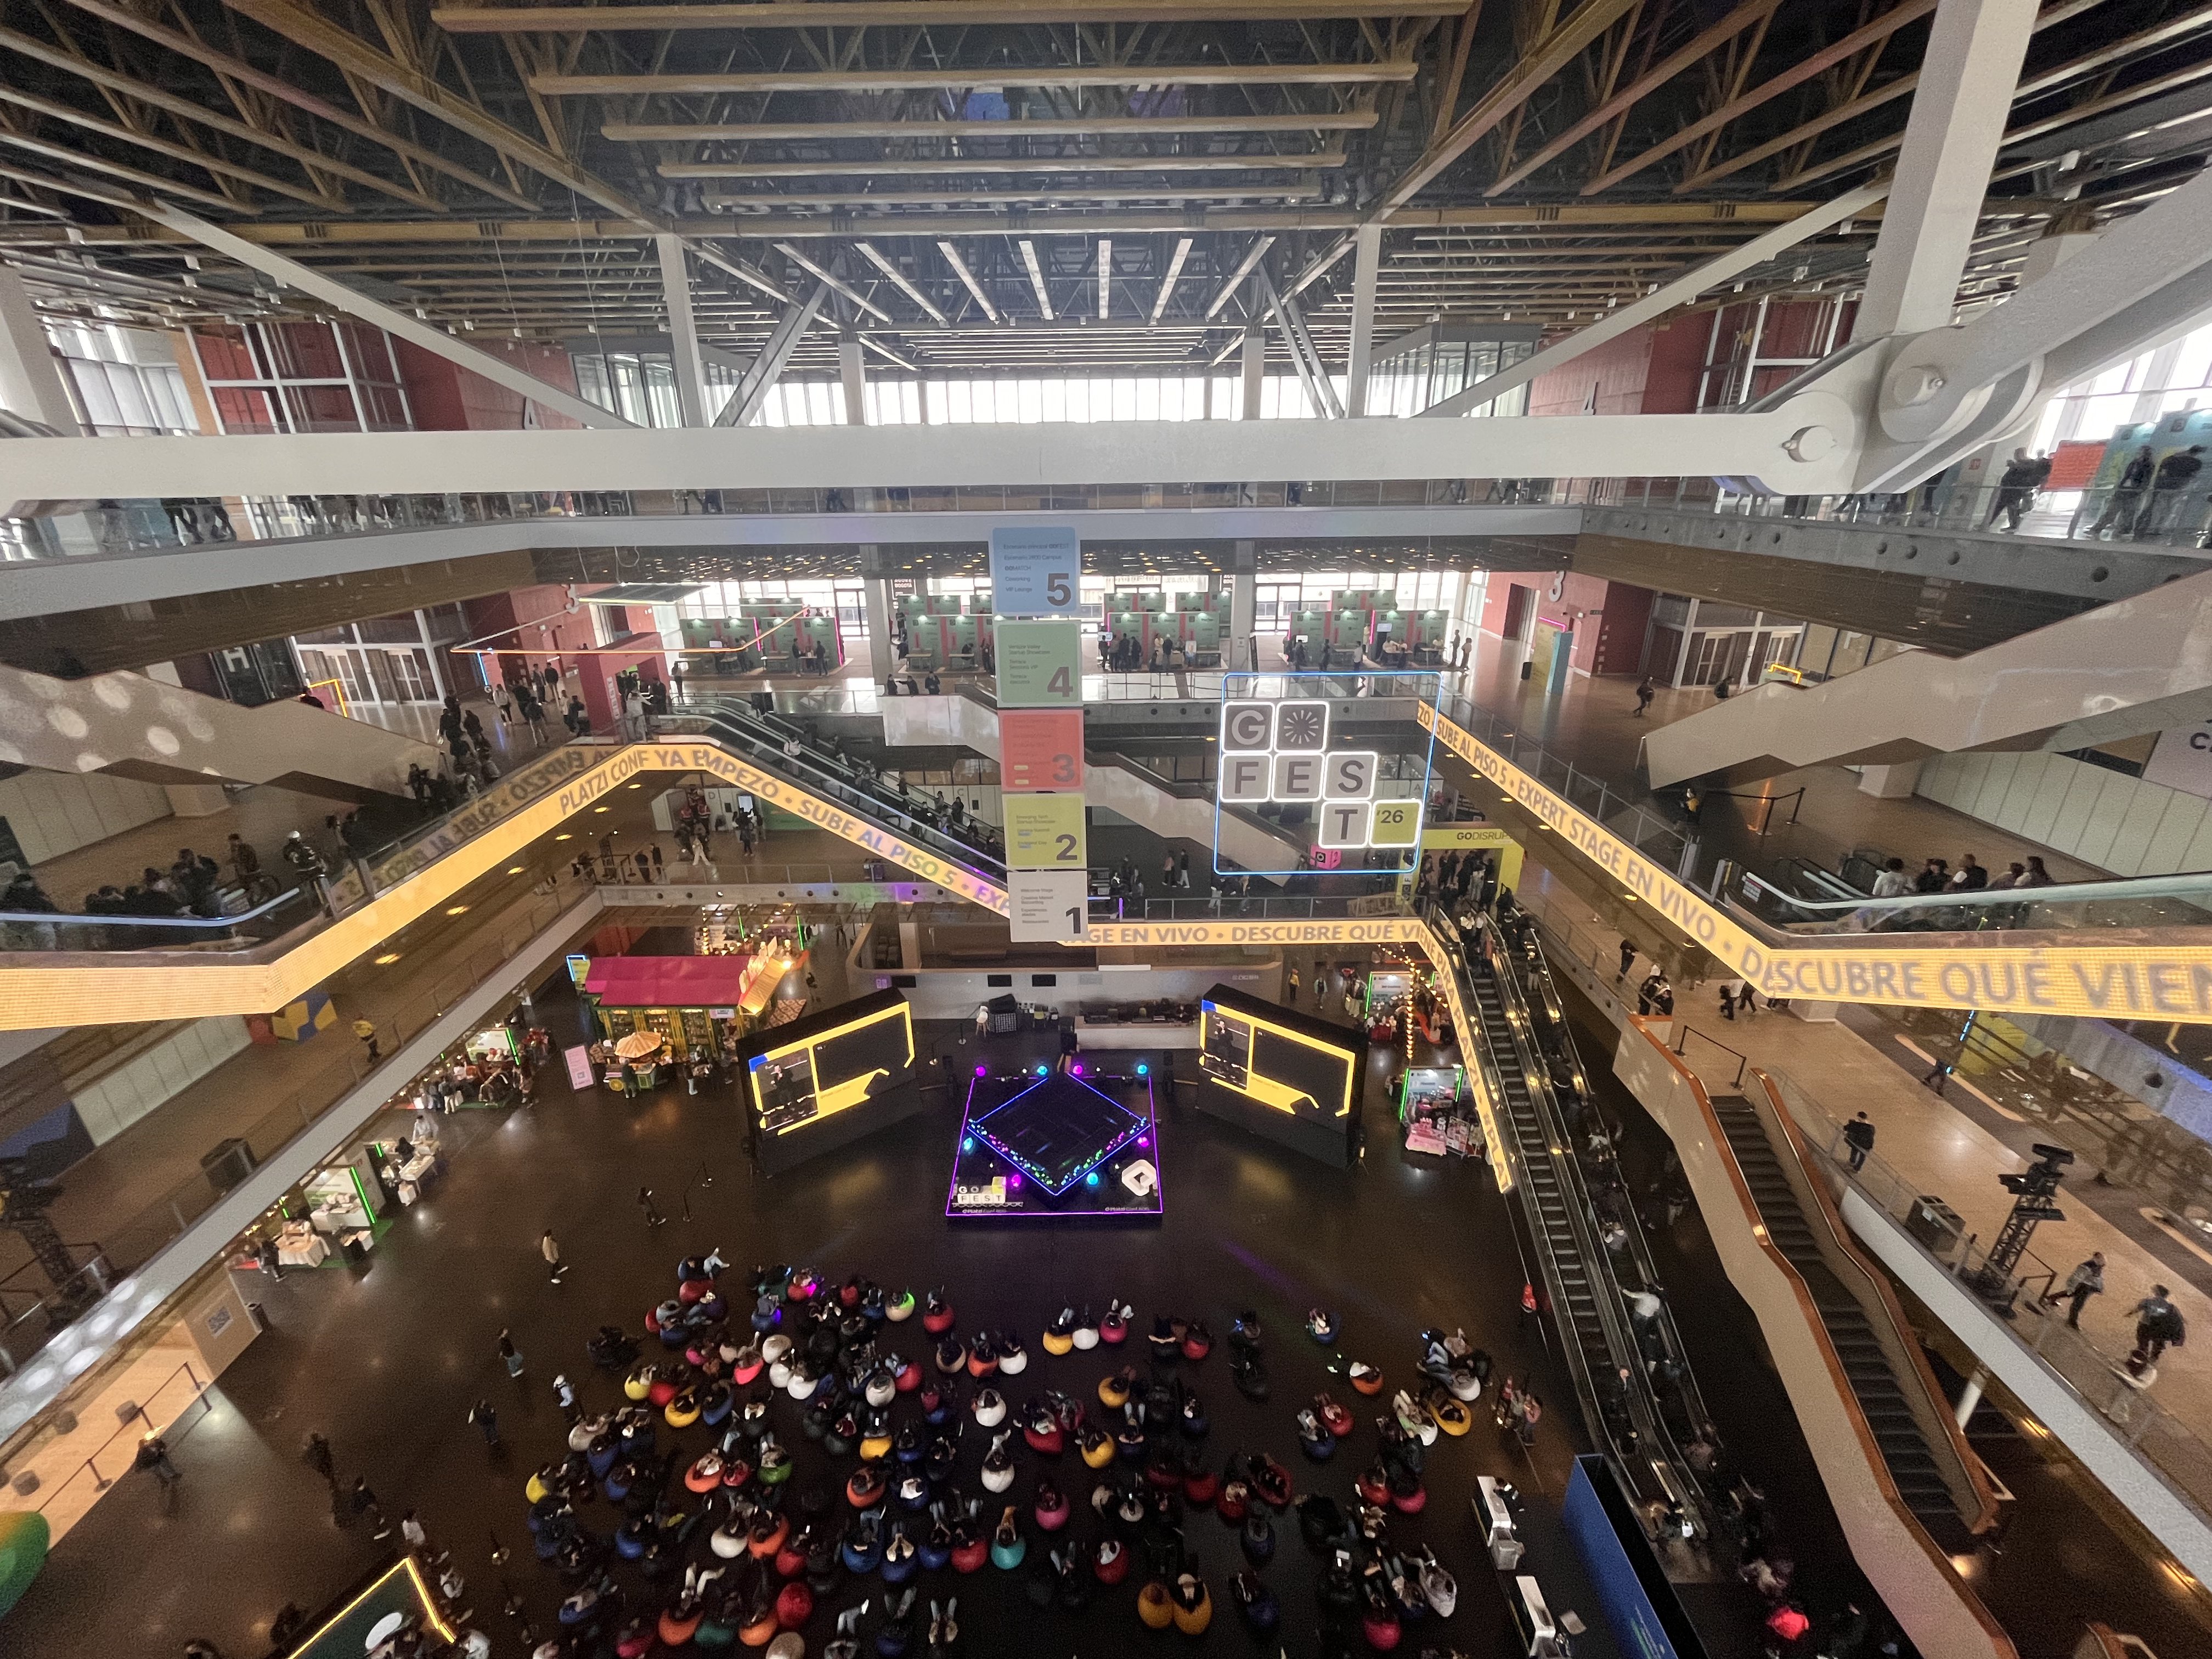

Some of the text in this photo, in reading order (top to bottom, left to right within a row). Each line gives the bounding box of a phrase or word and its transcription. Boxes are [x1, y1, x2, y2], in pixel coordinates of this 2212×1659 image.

[1047, 573, 1071, 606] 5
[1047, 667, 1073, 697] 4
[1052, 754, 1075, 782] 3
[559, 769, 609, 815] PLATZI
[611, 750, 650, 782] CONF
[654, 750, 687, 766] YA
[692, 749, 780, 799] EMPEZÓ
[798, 799, 857, 838] SUBE
[857, 828, 885, 854] AL
[889, 843, 940, 879] PISO
[941, 869, 958, 887] 5
[1055, 834, 1077, 861] 2
[1436, 719, 1459, 749] SUBE
[1459, 737, 1471, 759] AL
[1474, 745, 1498, 777] PISO
[1499, 764, 1508, 785] 5
[1517, 777, 1568, 829] EXPERT
[1569, 819, 1623, 874] STAGE
[1627, 857, 1654, 896] EN
[1659, 879, 1716, 944] VIVO
[1940, 949, 2056, 1008] QUÉ
[1065, 907, 1081, 934] 1
[1121, 928, 1149, 943] EN
[1155, 927, 1210, 943] VIVO
[1232, 925, 1344, 942] DESCUBRE
[1348, 921, 1395, 940] QUÉ
